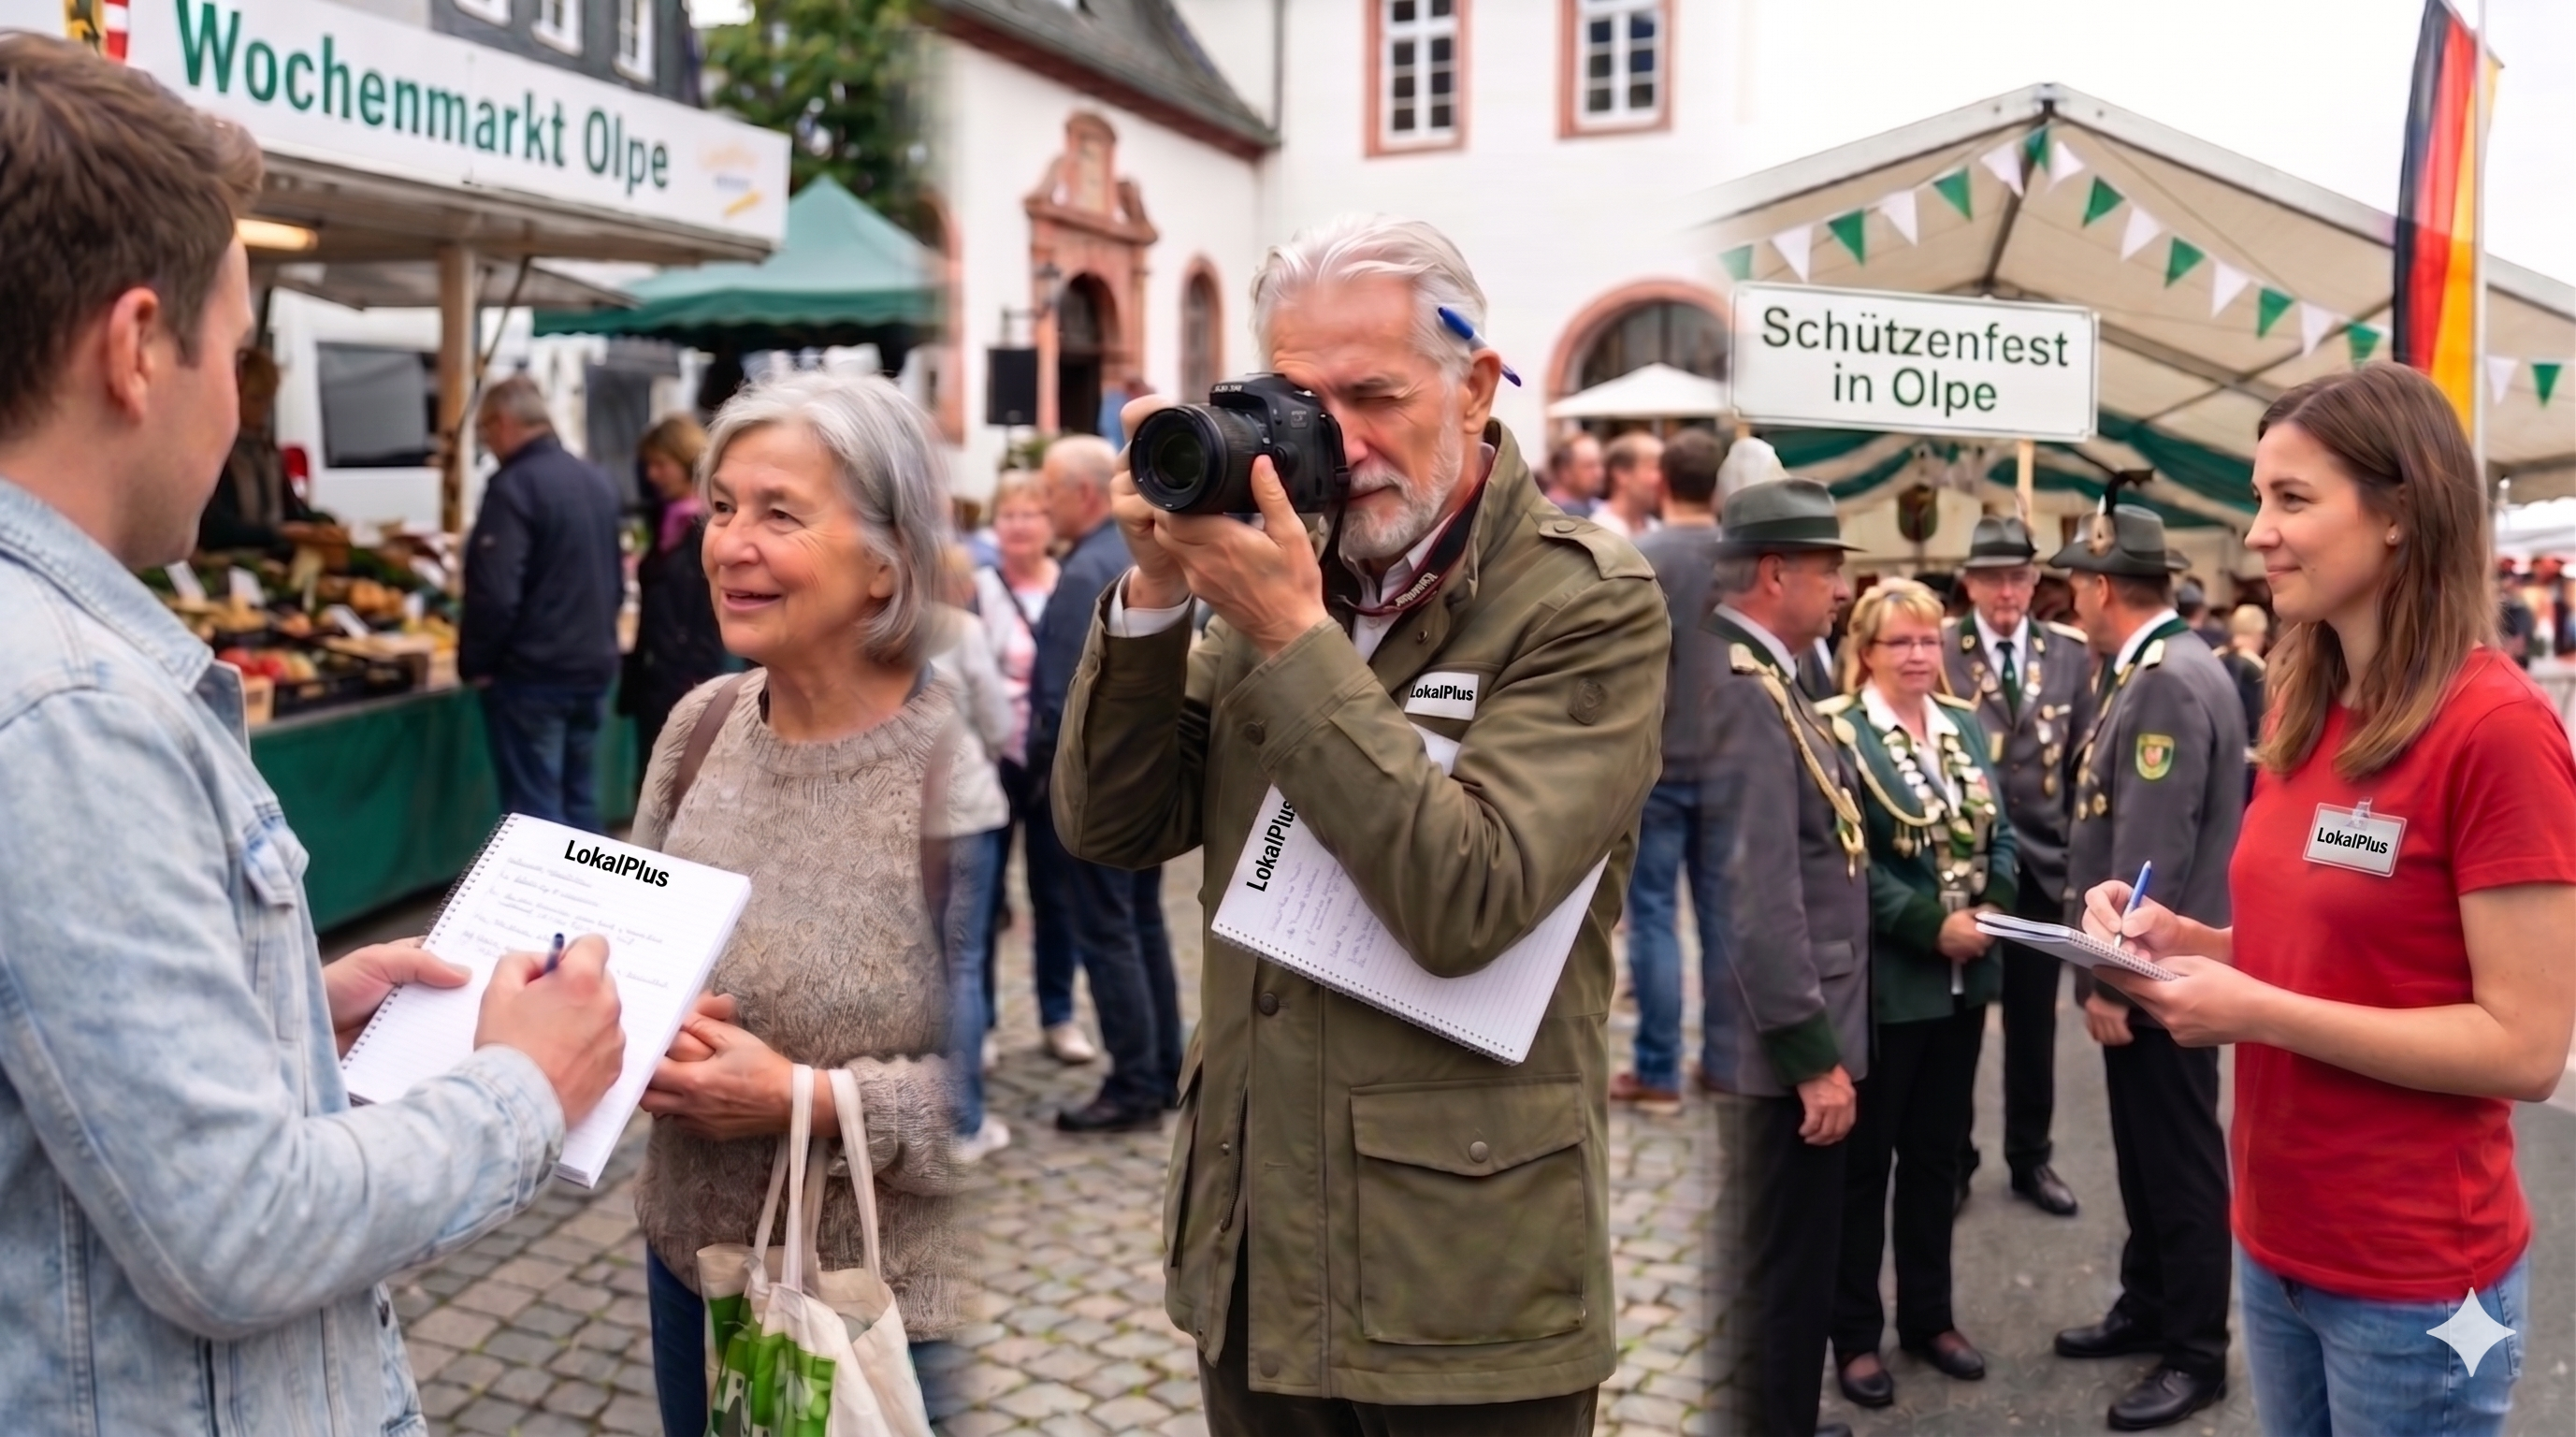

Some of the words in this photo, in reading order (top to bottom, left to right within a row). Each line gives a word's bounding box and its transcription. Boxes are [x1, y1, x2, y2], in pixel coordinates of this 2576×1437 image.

[175, 0, 566, 167] Wochenmarkt
[585, 109, 668, 196] Olpe
[1762, 306, 2069, 368] Schützenfest
[1834, 362, 1872, 403] in
[1892, 367, 1997, 417] Olpe
[1410, 684, 1474, 702] LokalPlus
[564, 839, 670, 888] LokalPlus
[2317, 827, 2389, 854] LokalPlus
